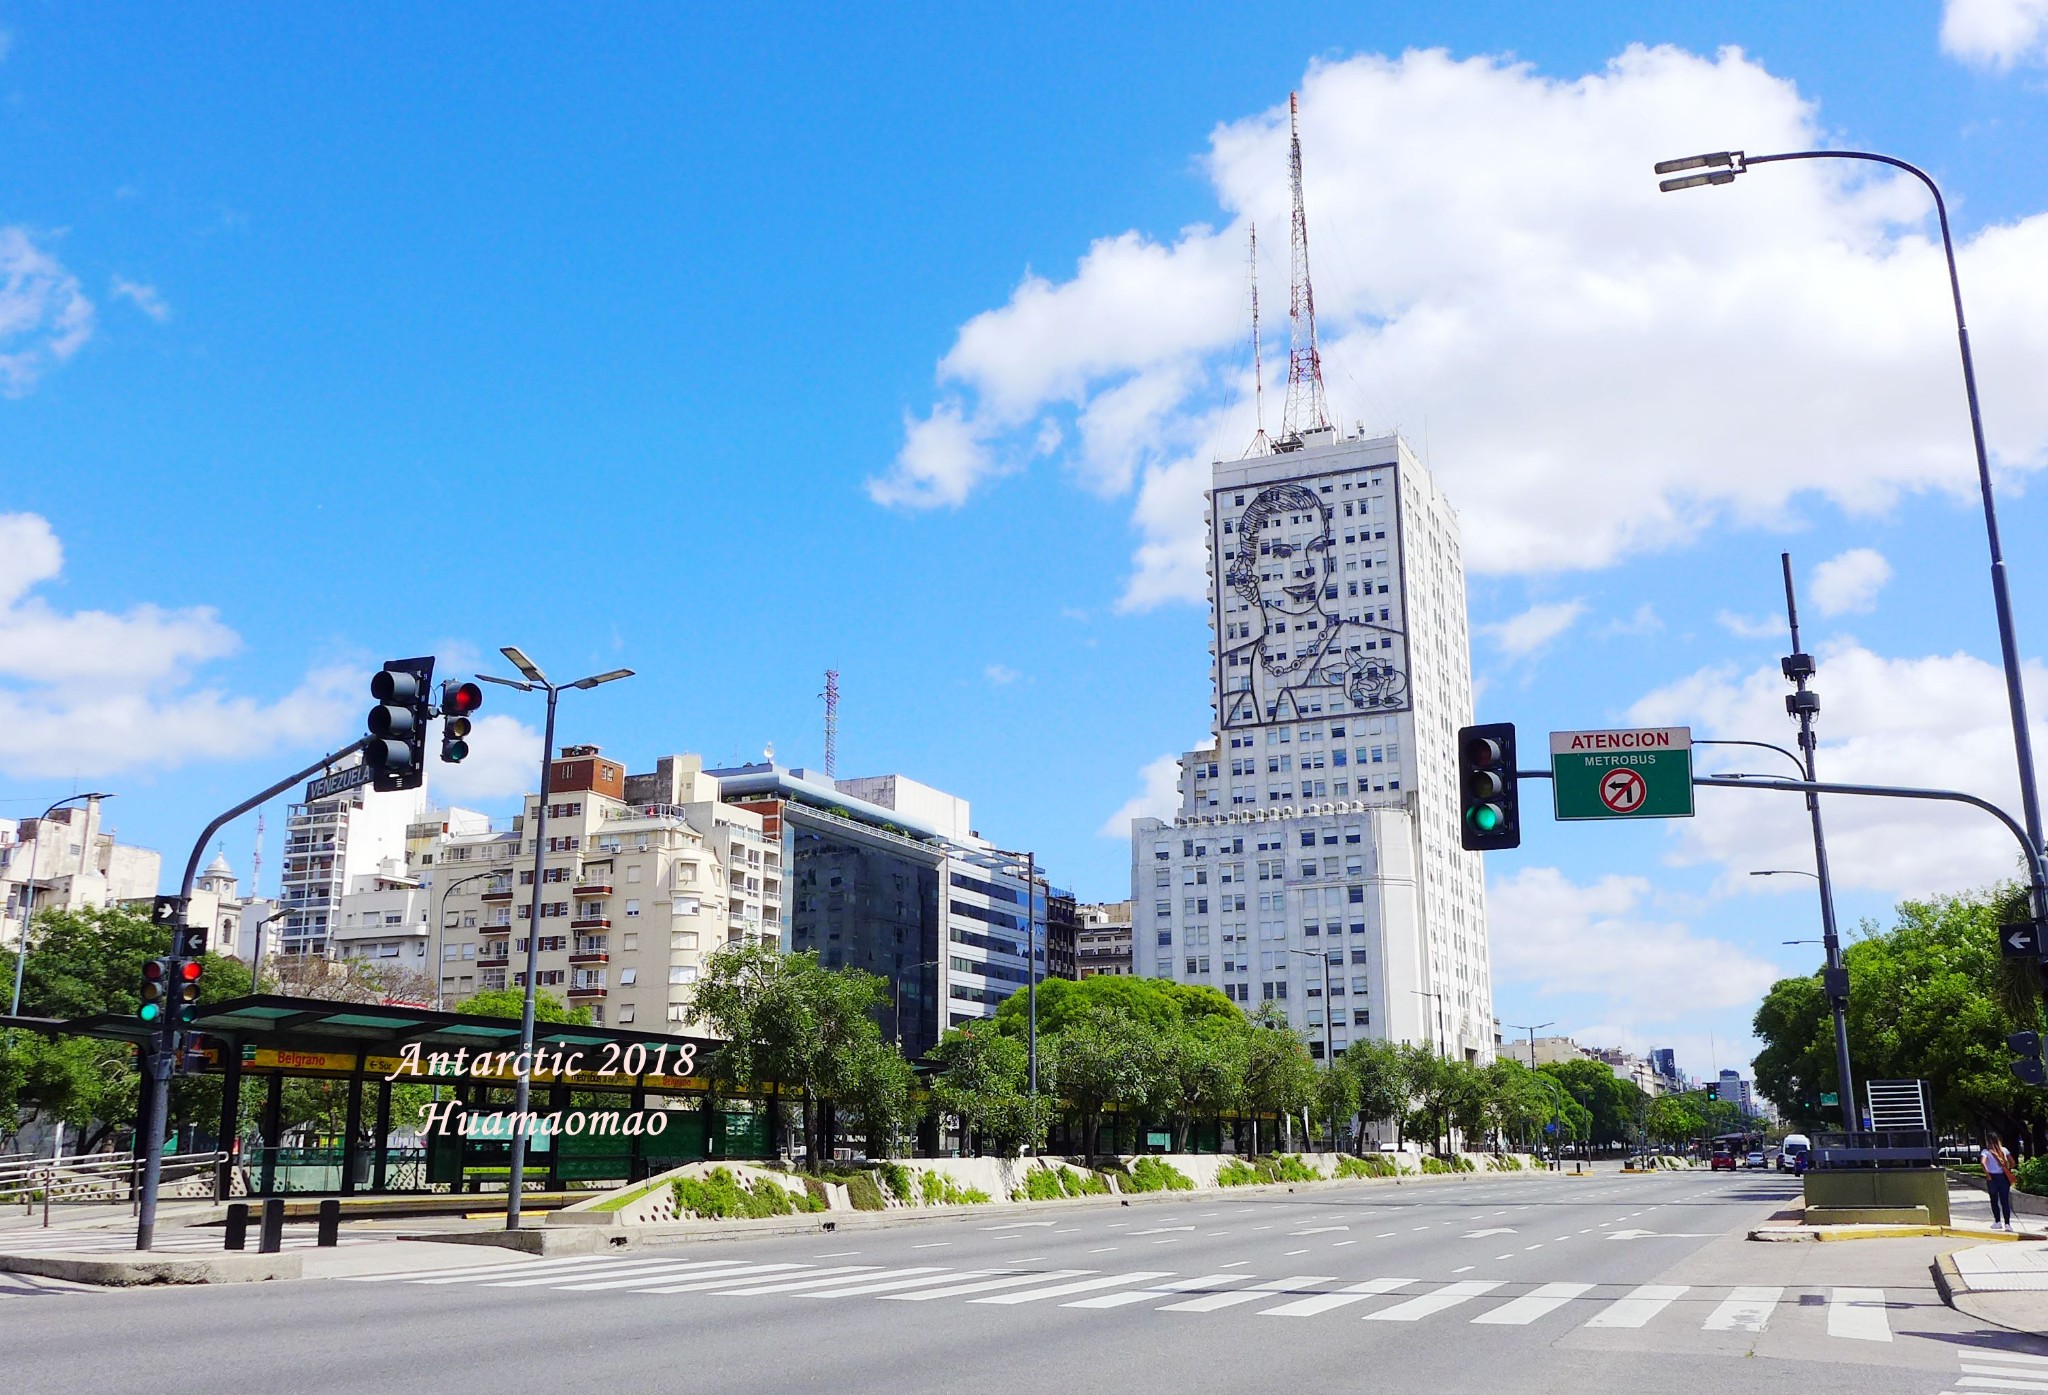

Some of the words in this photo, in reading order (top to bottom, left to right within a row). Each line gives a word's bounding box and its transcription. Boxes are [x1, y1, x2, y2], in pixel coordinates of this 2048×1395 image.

[1571, 731, 1670, 750] ATENCION
[1584, 754, 1657, 767] METROBUS
[310, 765, 371, 798] VENEZUELA
[277, 1051, 326, 1067] Belgrano
[379, 1060, 393, 1070] Sur
